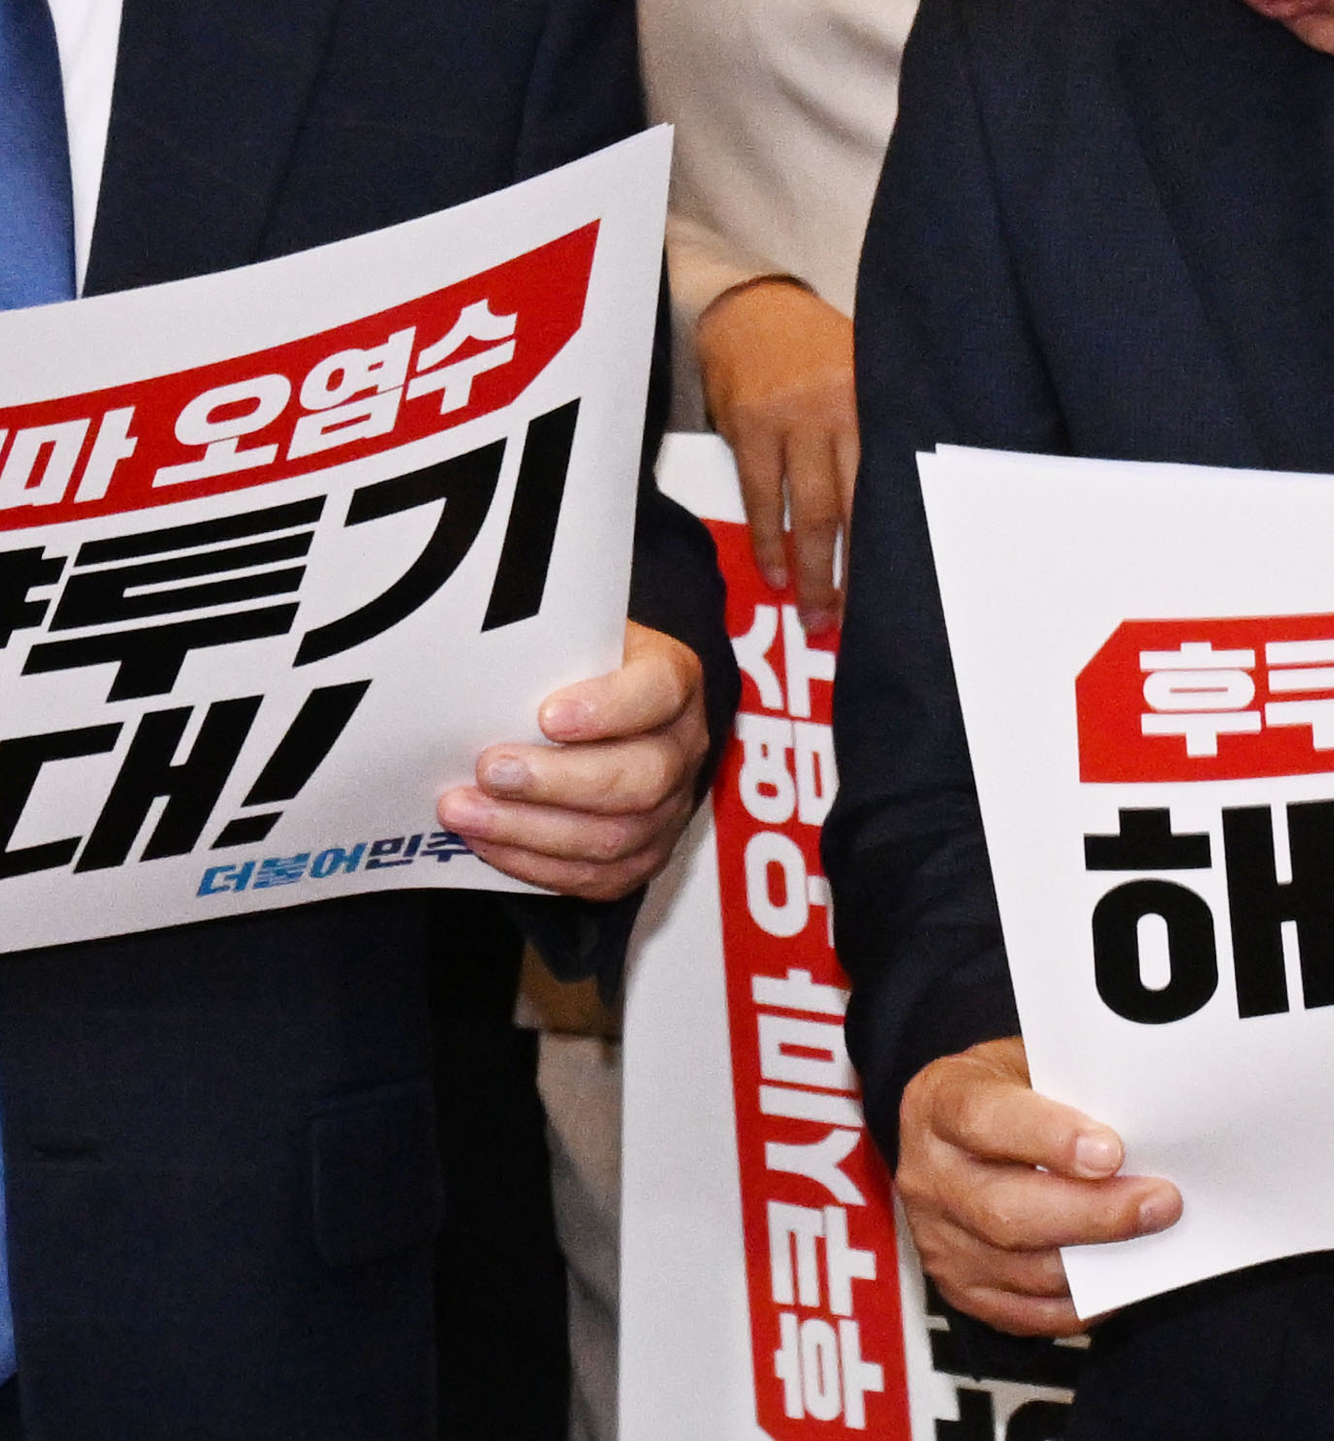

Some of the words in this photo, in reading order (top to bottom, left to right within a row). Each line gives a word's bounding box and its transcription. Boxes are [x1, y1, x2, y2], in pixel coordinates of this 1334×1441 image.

[154, 297, 518, 484] 오염수
[196, 831, 475, 898] 더불어민주
[751, 967, 885, 1430] 후쿠시마
